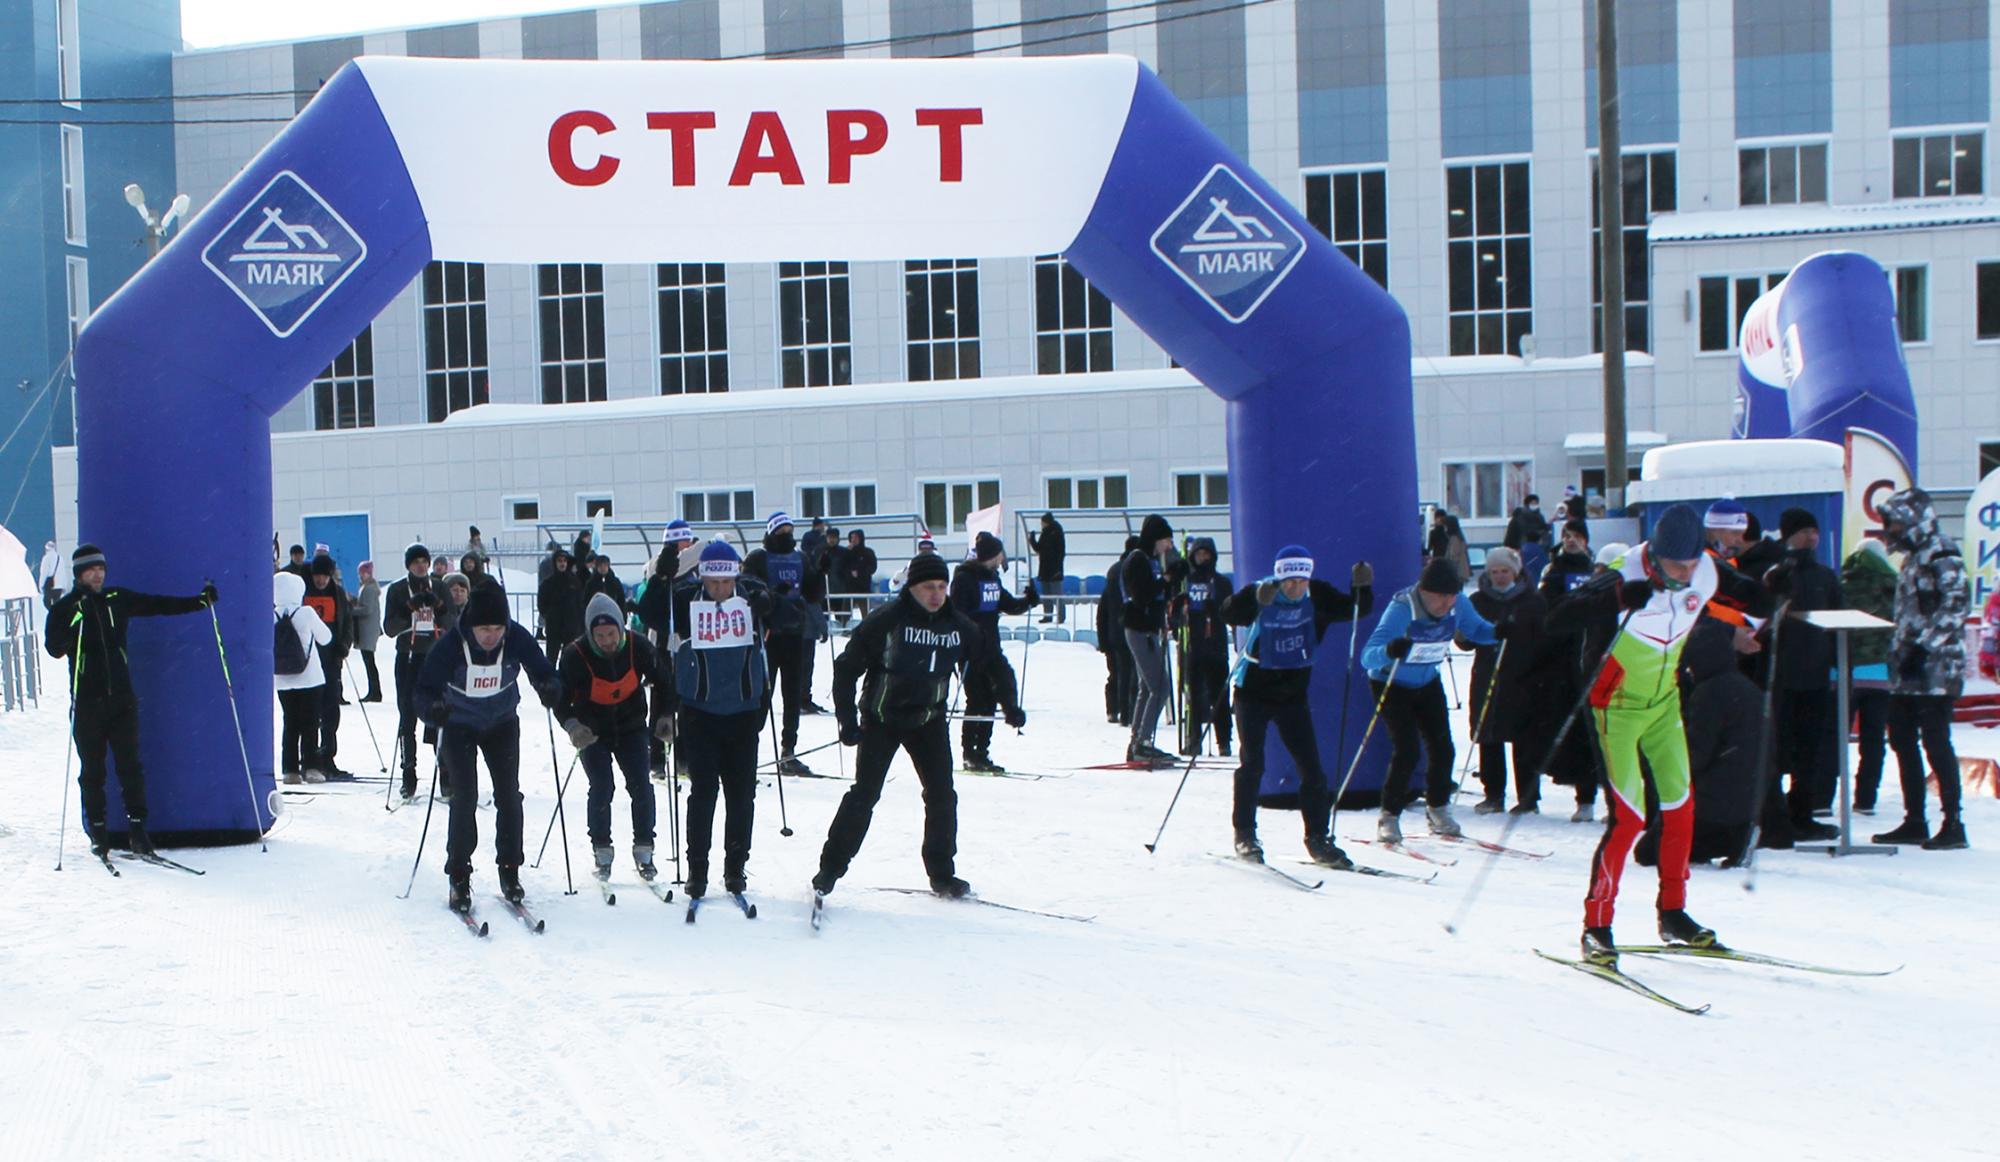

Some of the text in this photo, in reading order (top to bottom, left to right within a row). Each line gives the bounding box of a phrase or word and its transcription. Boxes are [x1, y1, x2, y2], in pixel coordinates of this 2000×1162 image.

[548, 107, 983, 187] СТАРТ
[247, 263, 325, 286] МАЯК
[1198, 251, 1275, 275] МАЯК
[697, 609, 747, 642] ЦРО
[473, 677, 498, 689] ПСП
